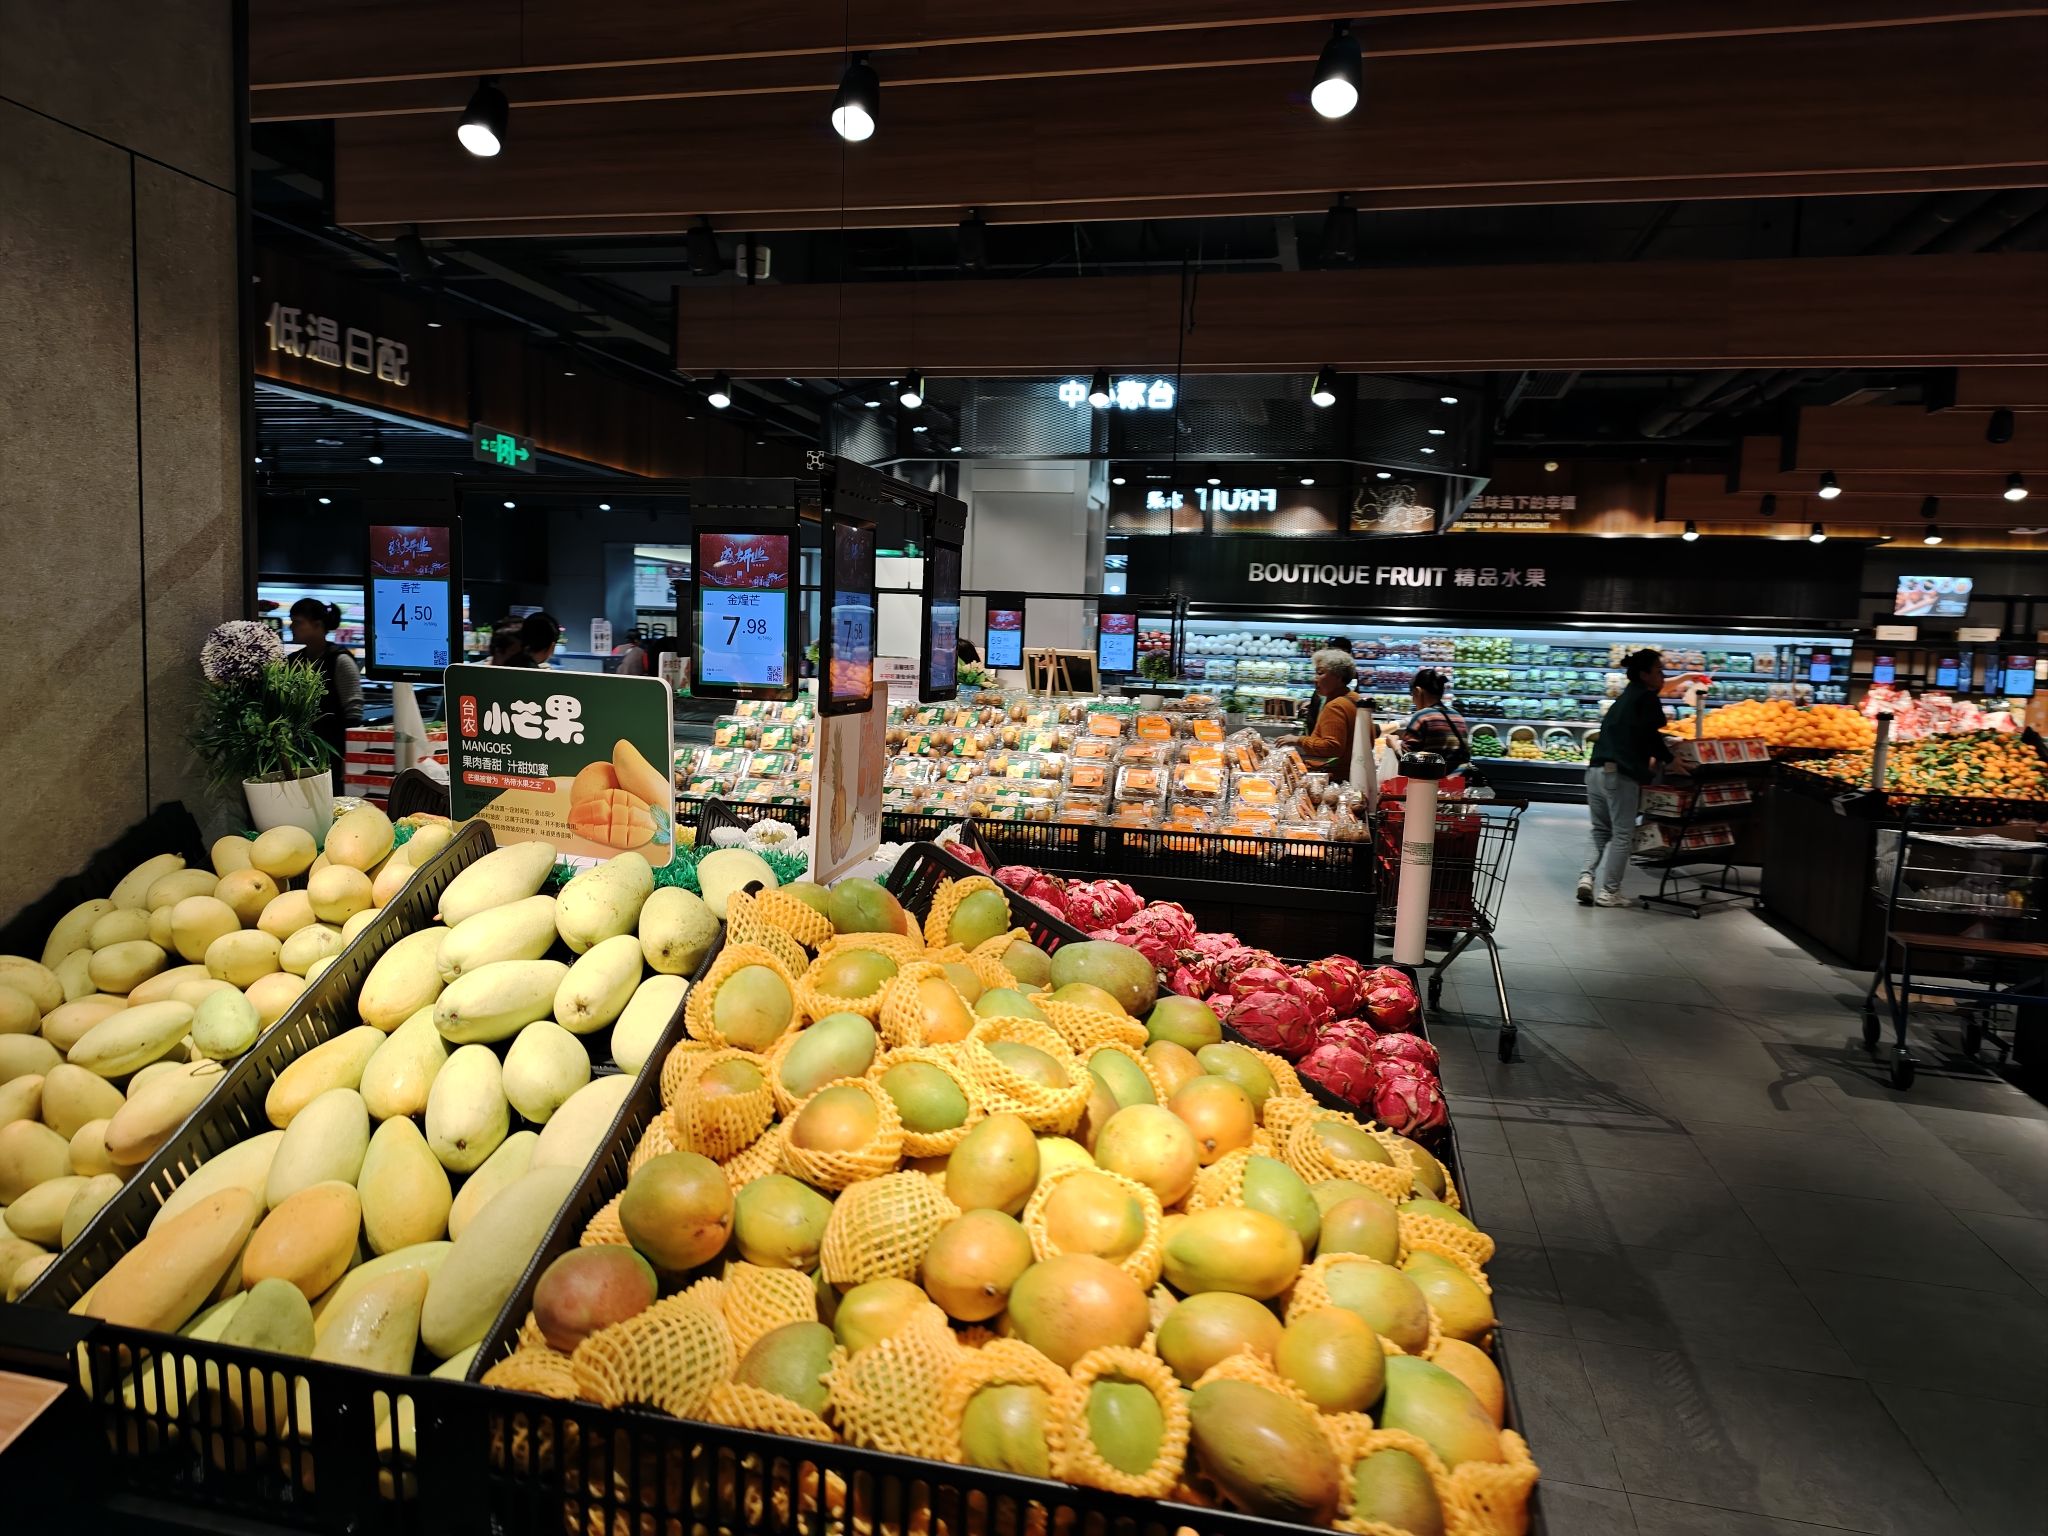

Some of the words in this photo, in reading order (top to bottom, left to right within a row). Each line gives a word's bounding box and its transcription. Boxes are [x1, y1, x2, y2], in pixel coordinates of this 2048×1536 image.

[265, 302, 410, 386] 低温日配
[1248, 562, 1370, 587] BOUTIQUE
[1375, 566, 1448, 587] FRUIT
[1453, 567, 1547, 588] 精品水果
[400, 582, 422, 594] 香芒
[727, 593, 761, 606] 金煌芒
[462, 699, 476, 733] 台农
[483, 694, 585, 745] 小芒果
[461, 739, 512, 755] MANGOES
[462, 755, 502, 772] 果肉香甜
[507, 759, 549, 777] 汁甜如蜜
